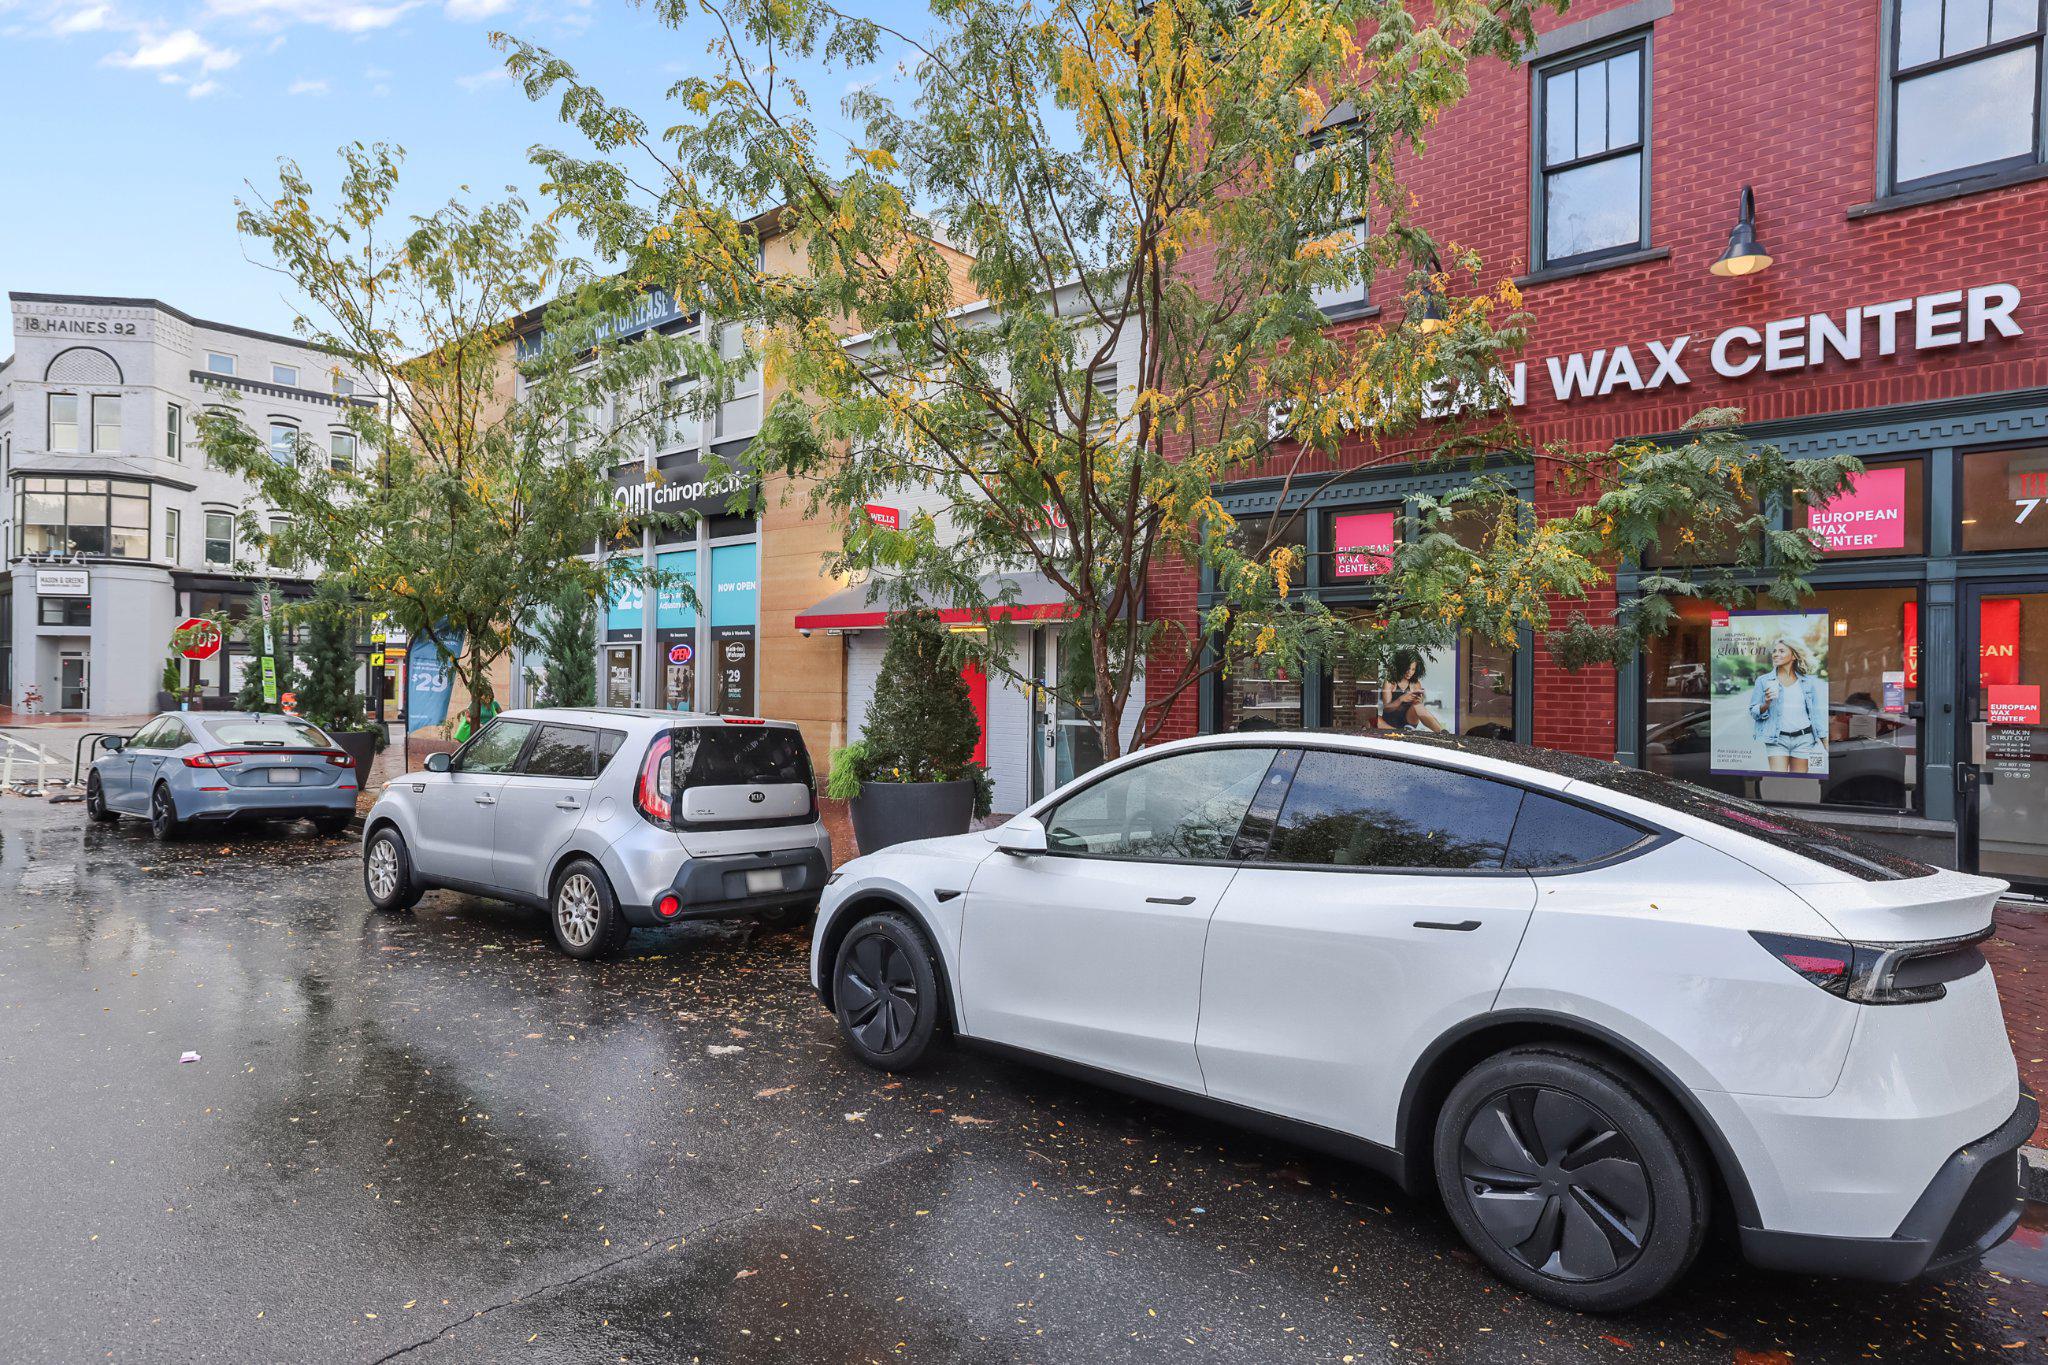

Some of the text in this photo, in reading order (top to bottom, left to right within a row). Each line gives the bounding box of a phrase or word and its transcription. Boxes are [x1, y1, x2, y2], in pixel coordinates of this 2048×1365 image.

[1546, 336, 1692, 401] WAX
[1710, 283, 2025, 378] CENTER
[870, 512, 895, 523] WELLS
[1812, 508, 1898, 524] EUROPEAN
[1812, 524, 1842, 536] WAX
[1338, 555, 1360, 564] WAX
[1338, 563, 1376, 573] CENTER
[718, 580, 756, 593] NOW OPEN
[671, 648, 690, 661] OPEN
[1716, 643, 1767, 659] glow on
[1990, 703, 2038, 711] EUROPEAN
